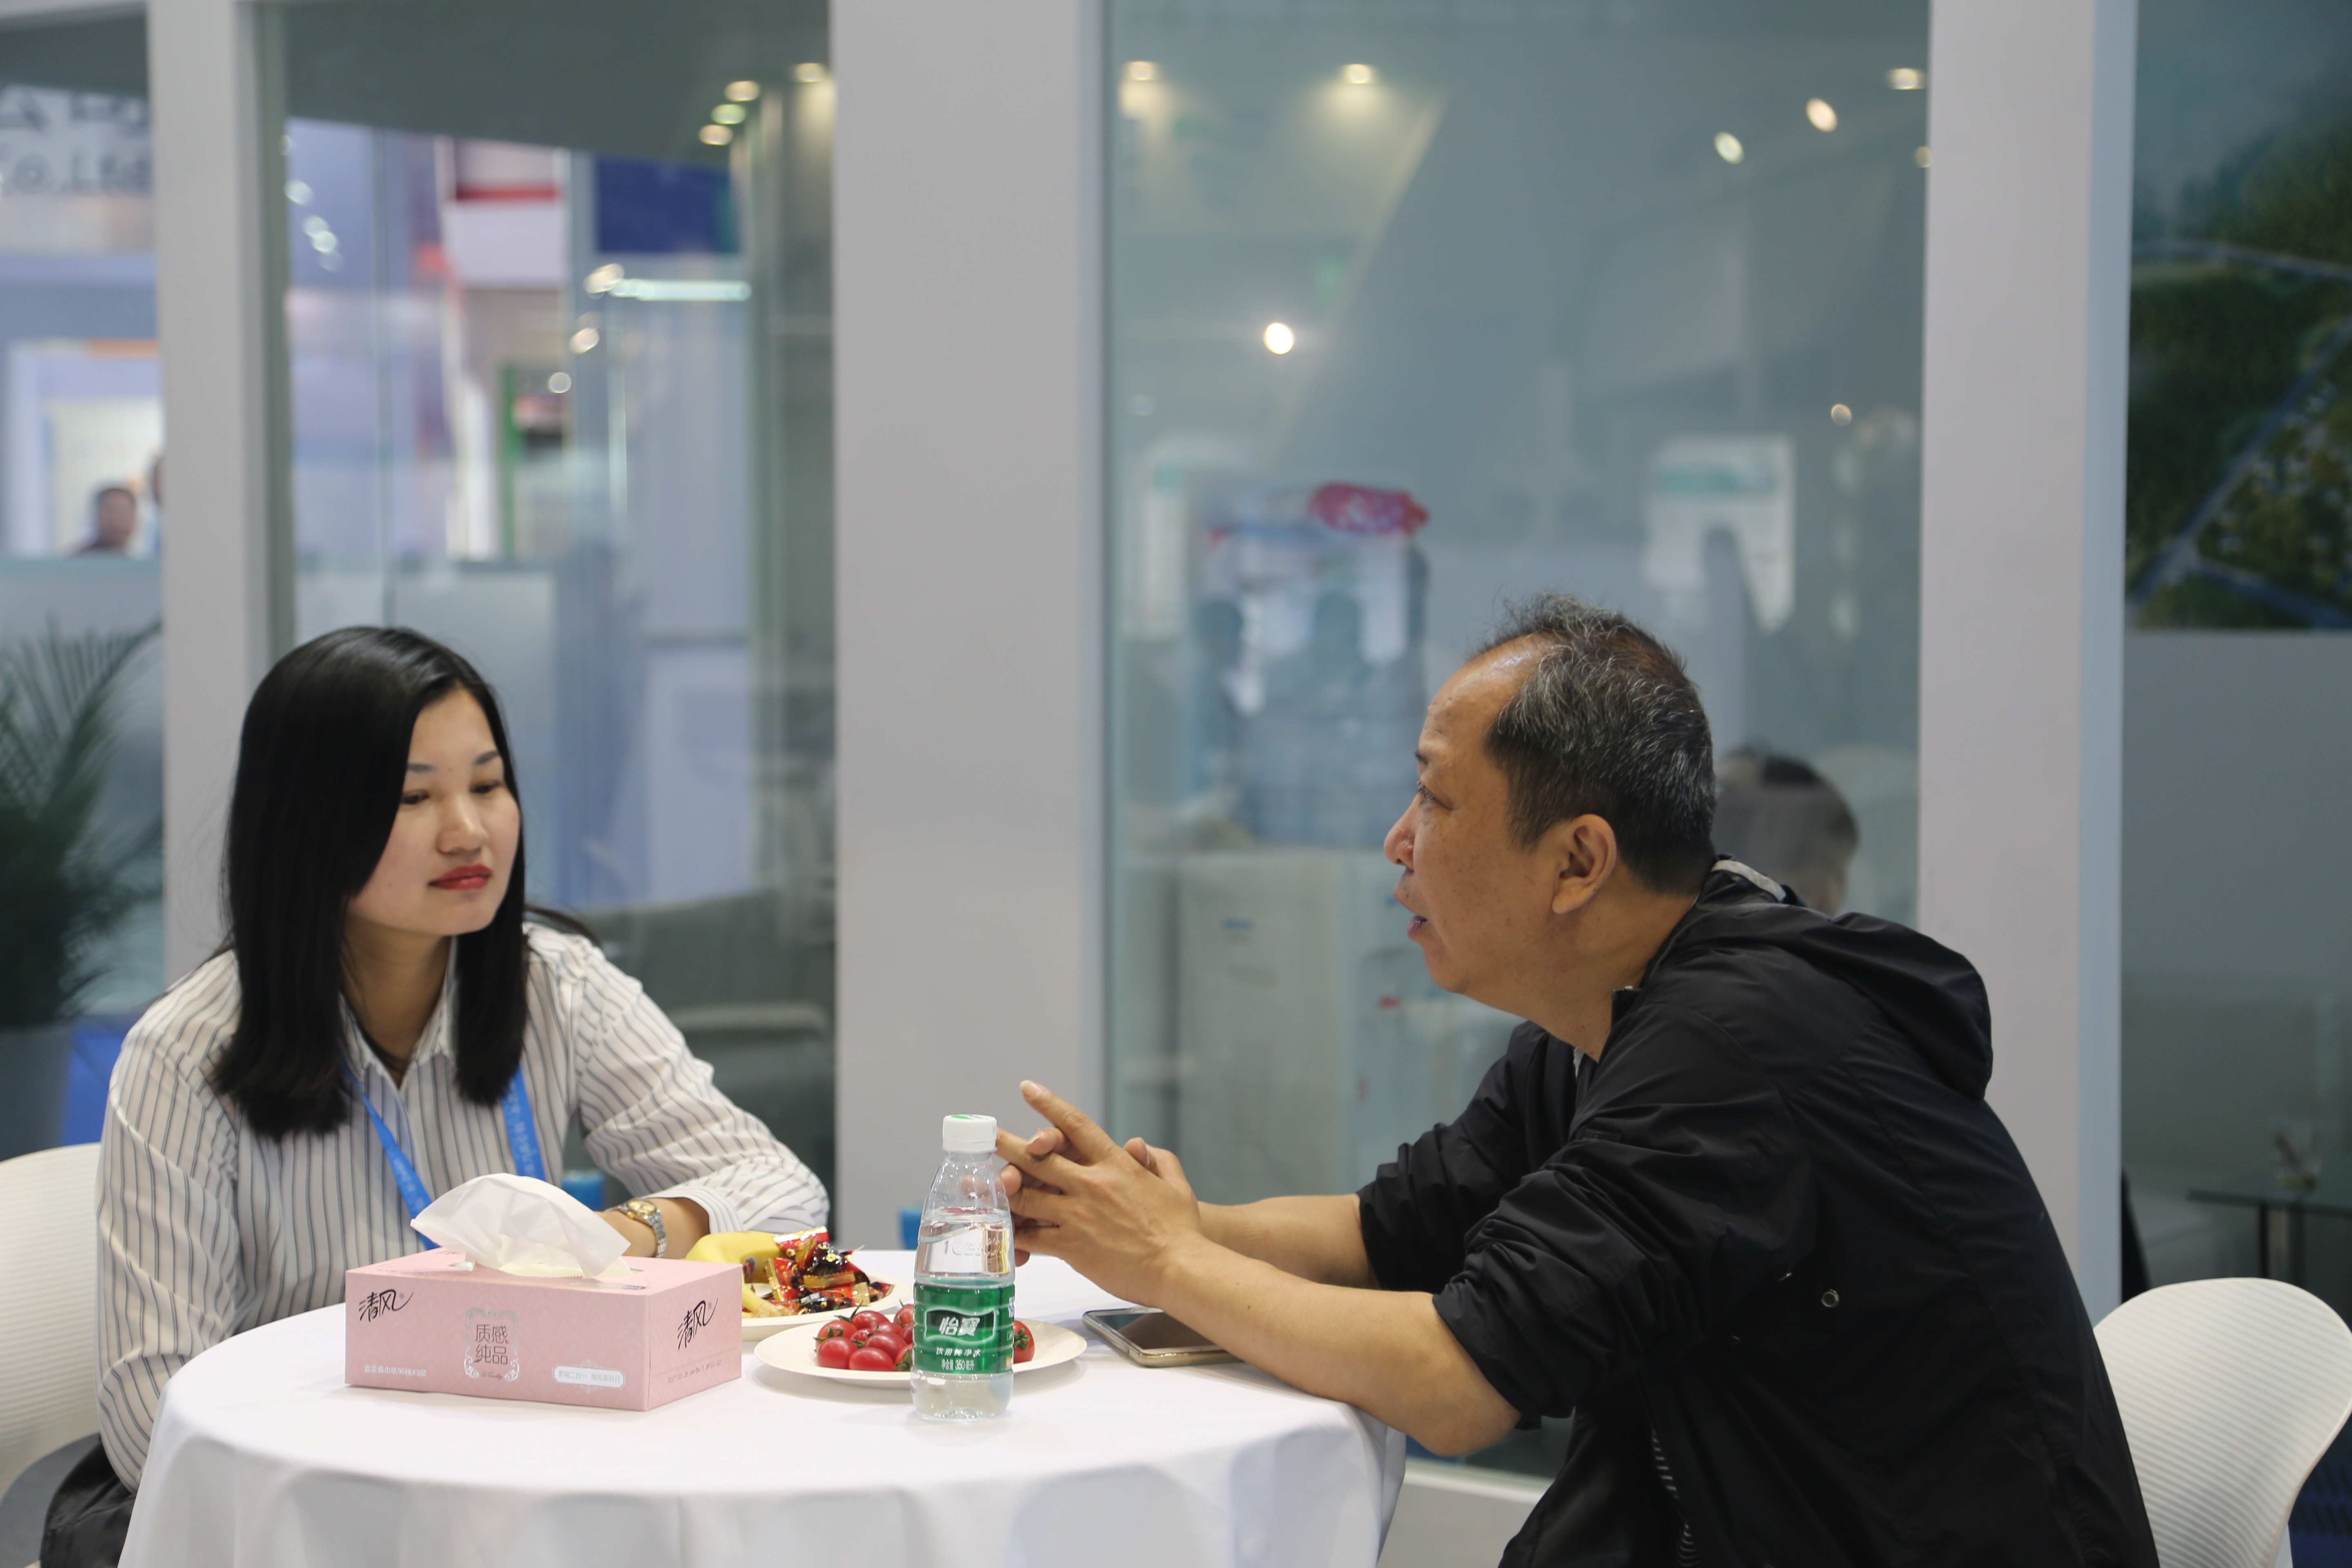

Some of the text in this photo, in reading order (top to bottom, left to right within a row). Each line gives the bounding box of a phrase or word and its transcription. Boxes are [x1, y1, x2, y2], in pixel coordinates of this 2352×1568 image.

[359, 1289, 414, 1322] 清风
[677, 1297, 718, 1350] 清风
[475, 1324, 509, 1344] 质感
[474, 1344, 508, 1364] 纯品
[936, 1347, 981, 1357] 饮用纯净水
